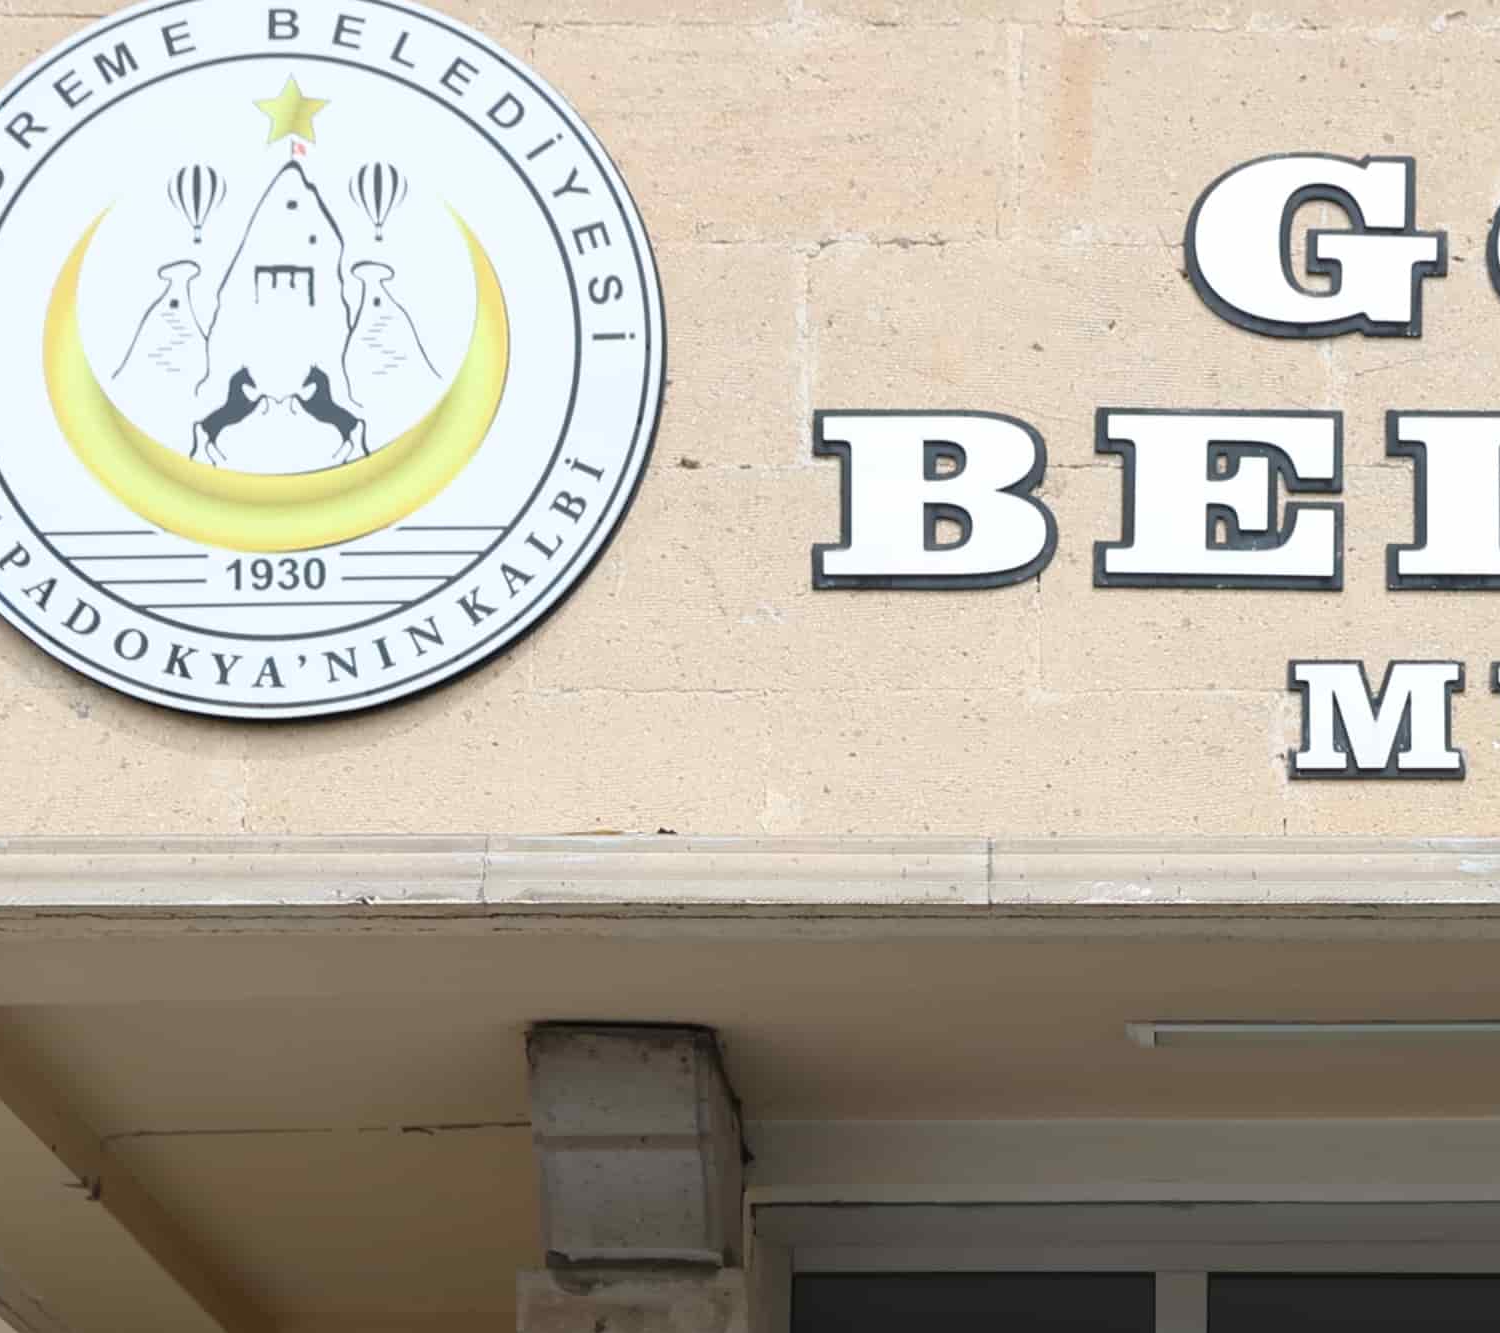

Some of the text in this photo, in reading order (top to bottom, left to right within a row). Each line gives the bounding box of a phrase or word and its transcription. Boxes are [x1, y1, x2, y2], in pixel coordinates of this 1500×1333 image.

[266, 7, 637, 344] BELEDİYESİ
[225, 557, 328, 592] 1930
[461, 455, 607, 628] KALBİ
